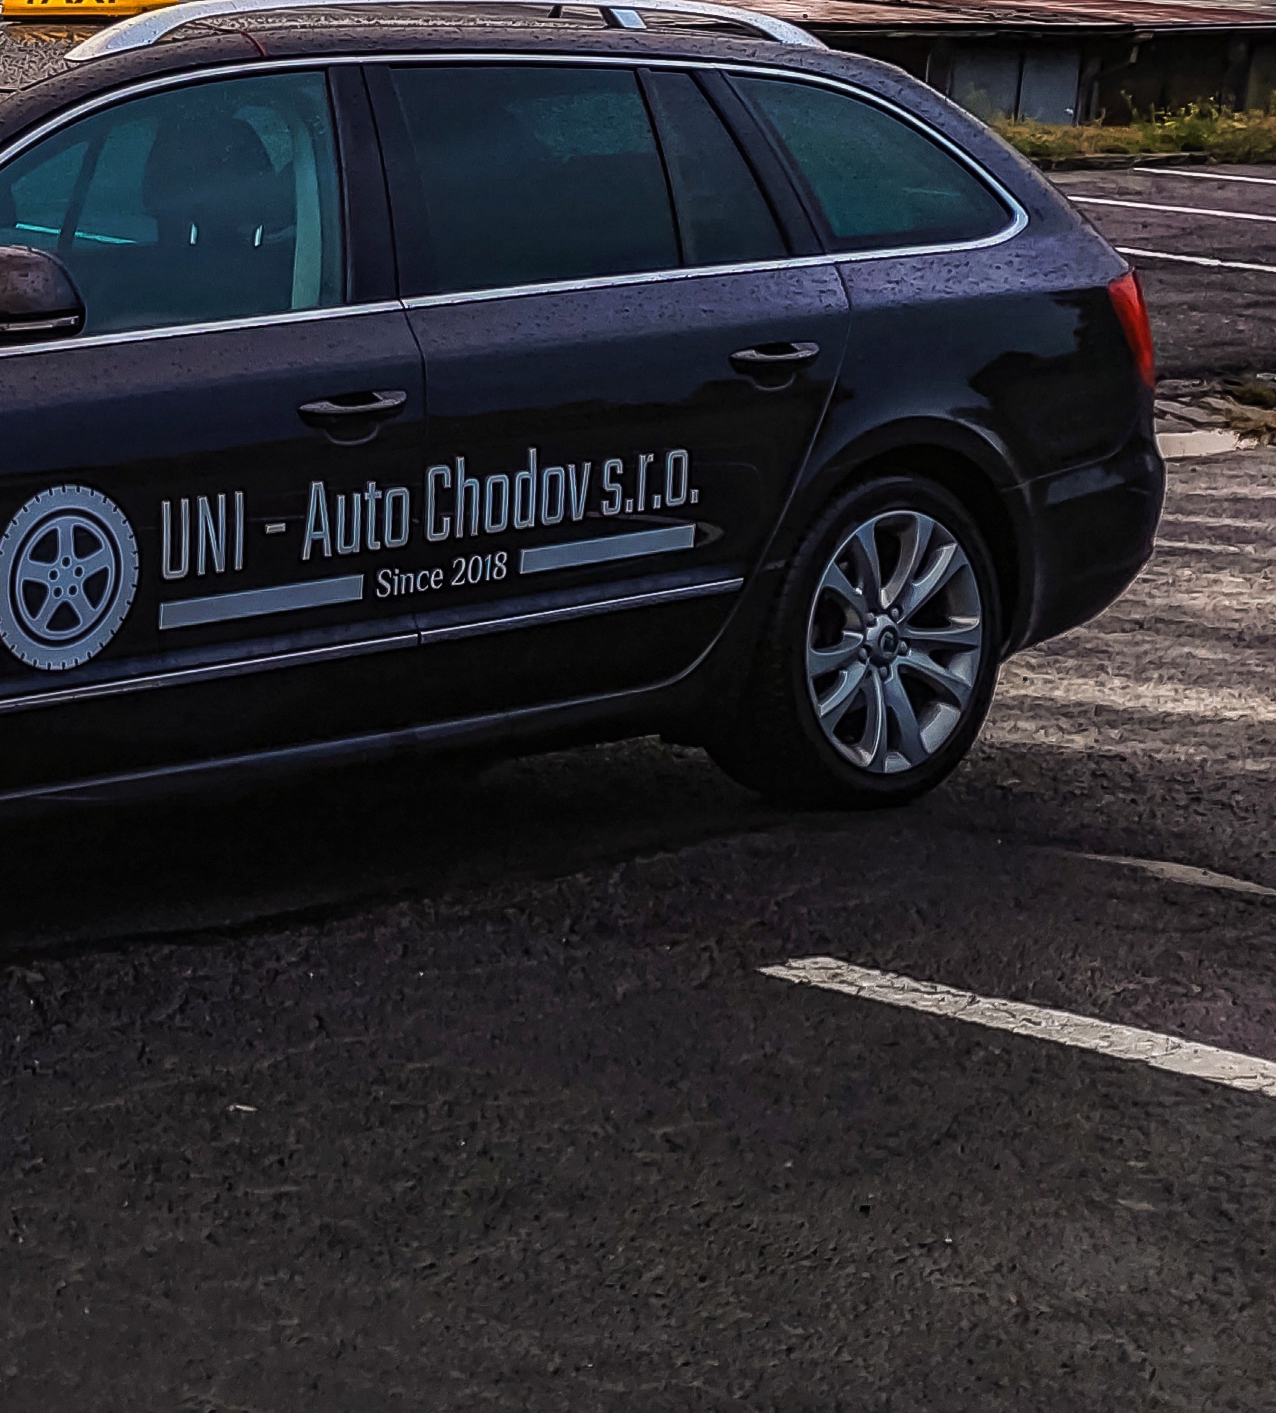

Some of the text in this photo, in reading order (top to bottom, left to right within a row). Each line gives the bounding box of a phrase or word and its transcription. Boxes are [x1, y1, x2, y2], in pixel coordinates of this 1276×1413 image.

[161, 447, 700, 581] UNI - Auto Chodov s.r.o.
[375, 550, 509, 599] Since 2018
